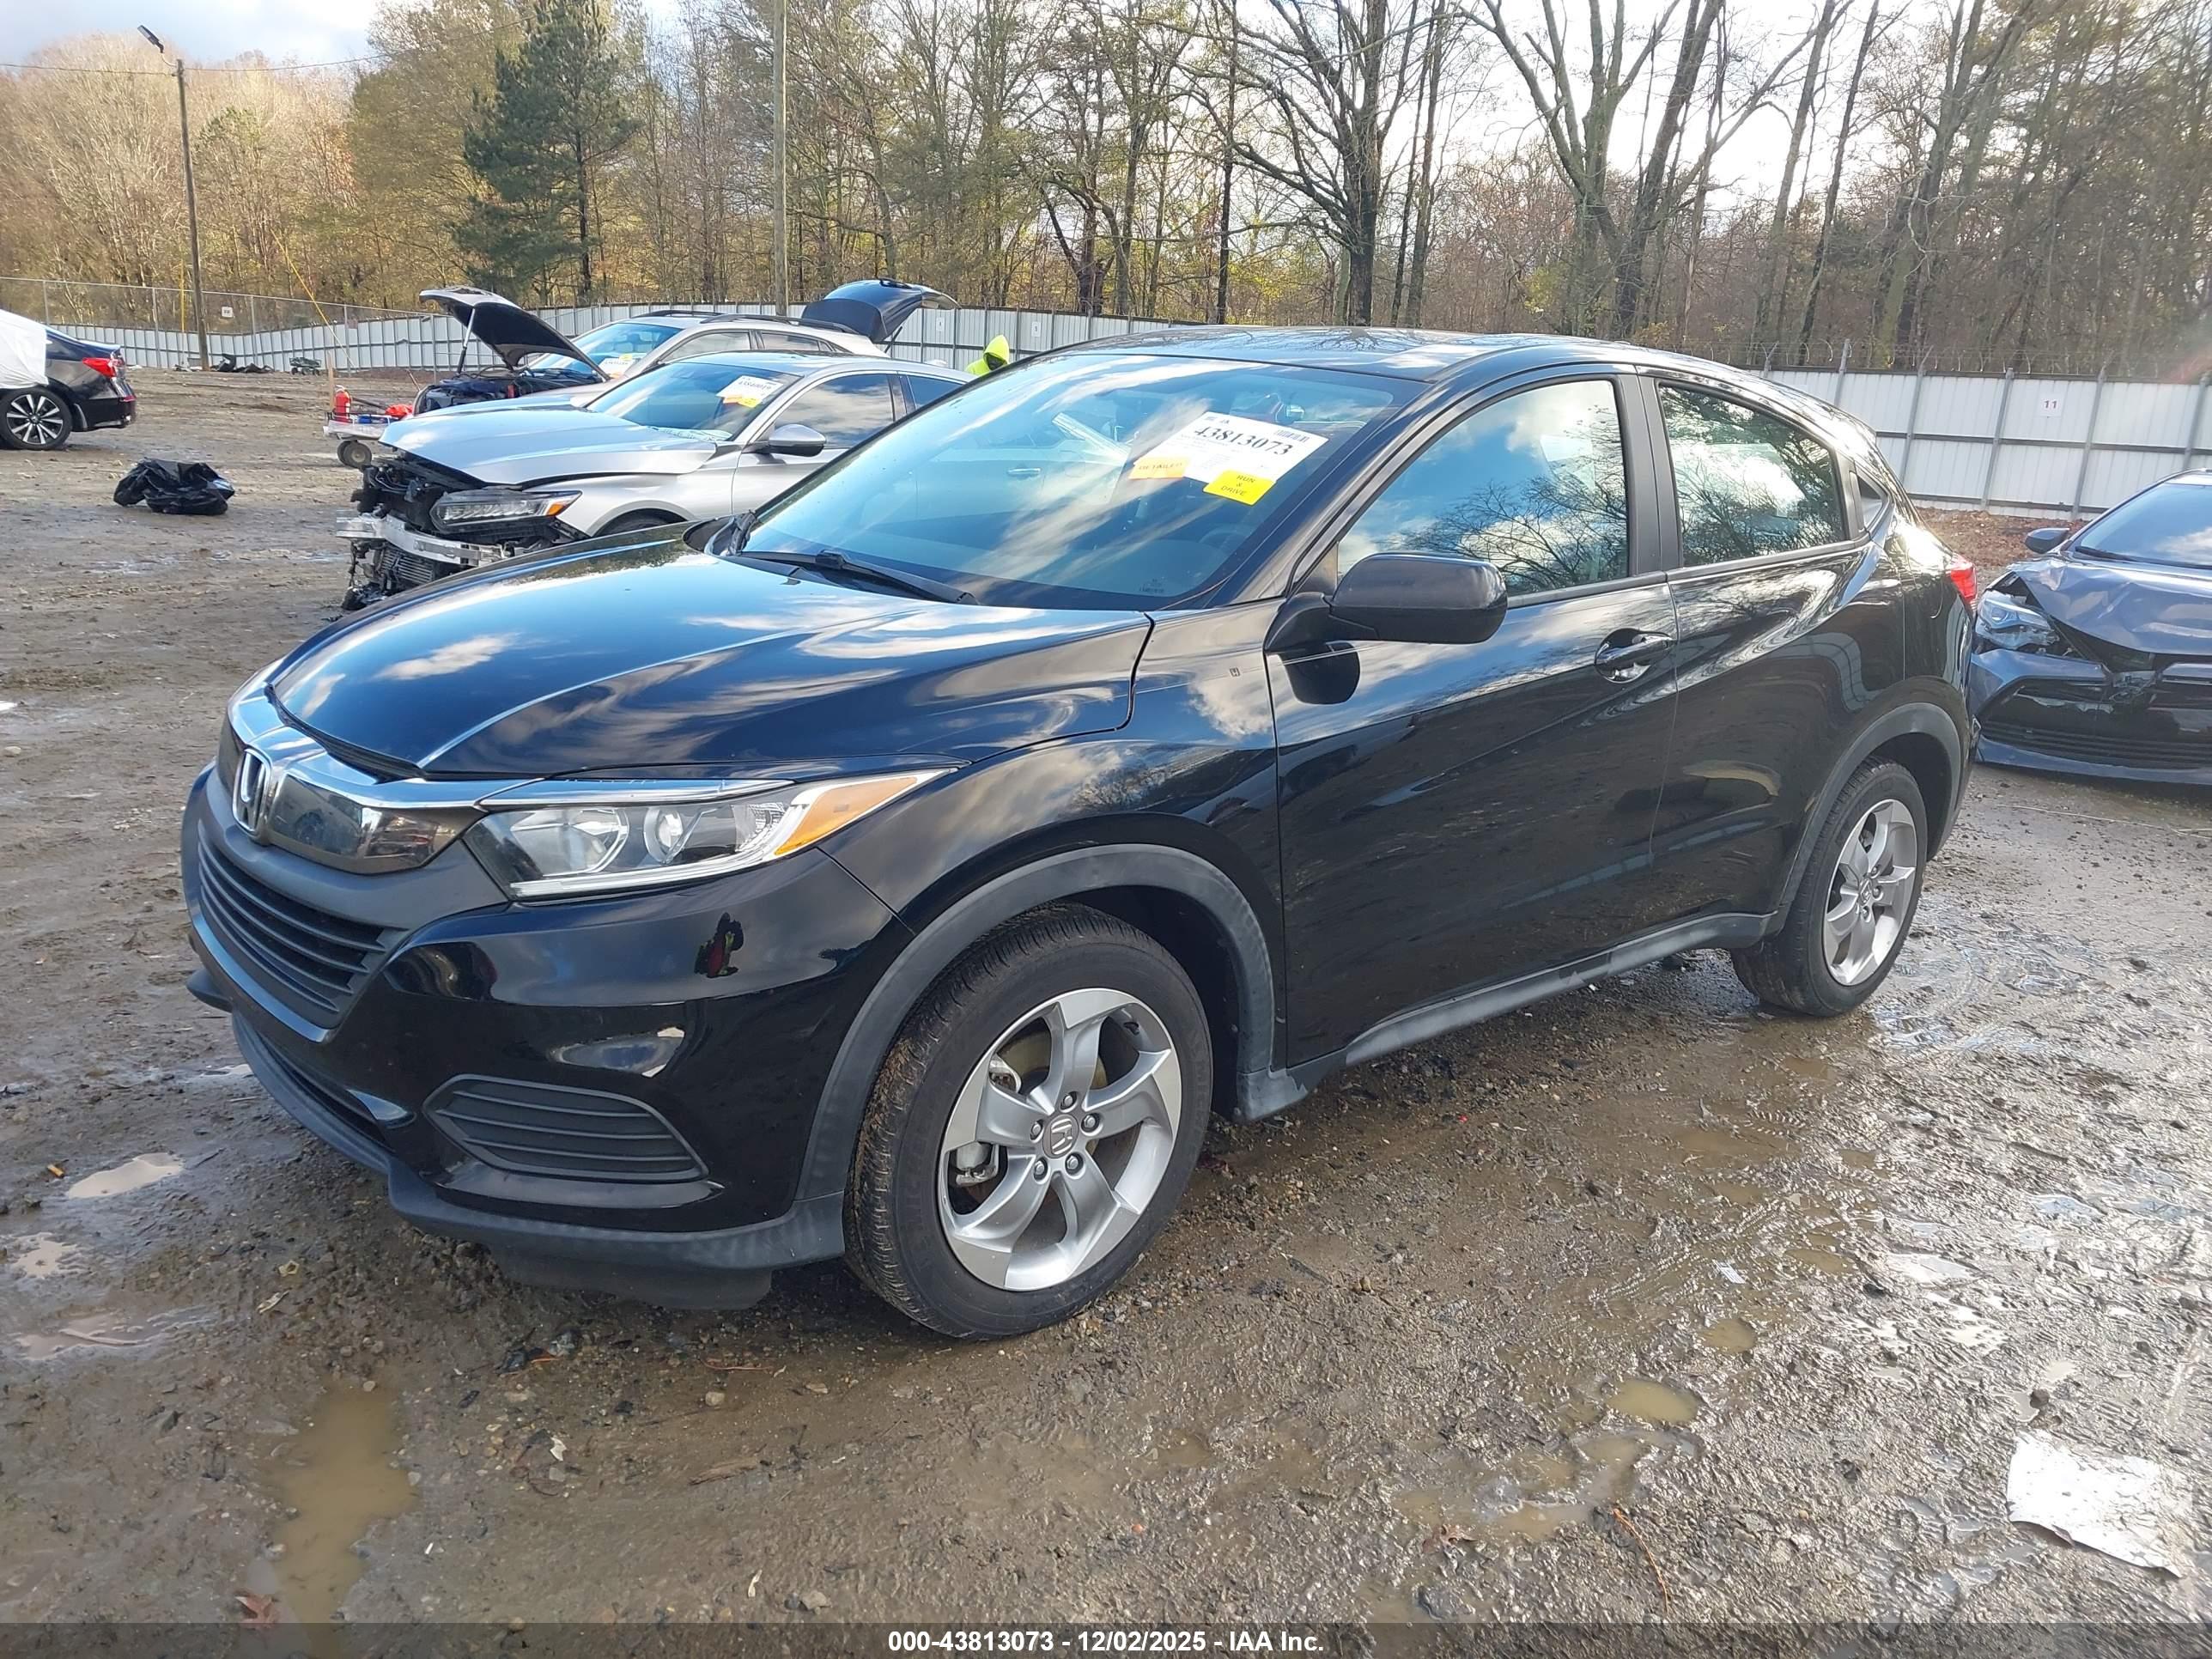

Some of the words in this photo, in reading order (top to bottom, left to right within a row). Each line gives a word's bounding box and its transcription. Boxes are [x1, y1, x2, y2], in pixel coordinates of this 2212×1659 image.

[2044, 400, 2057, 409] 11
[1194, 426, 1294, 455] 43813073
[1237, 475, 1255, 483] RUN
[1221, 485, 1248, 496] DRIVE
